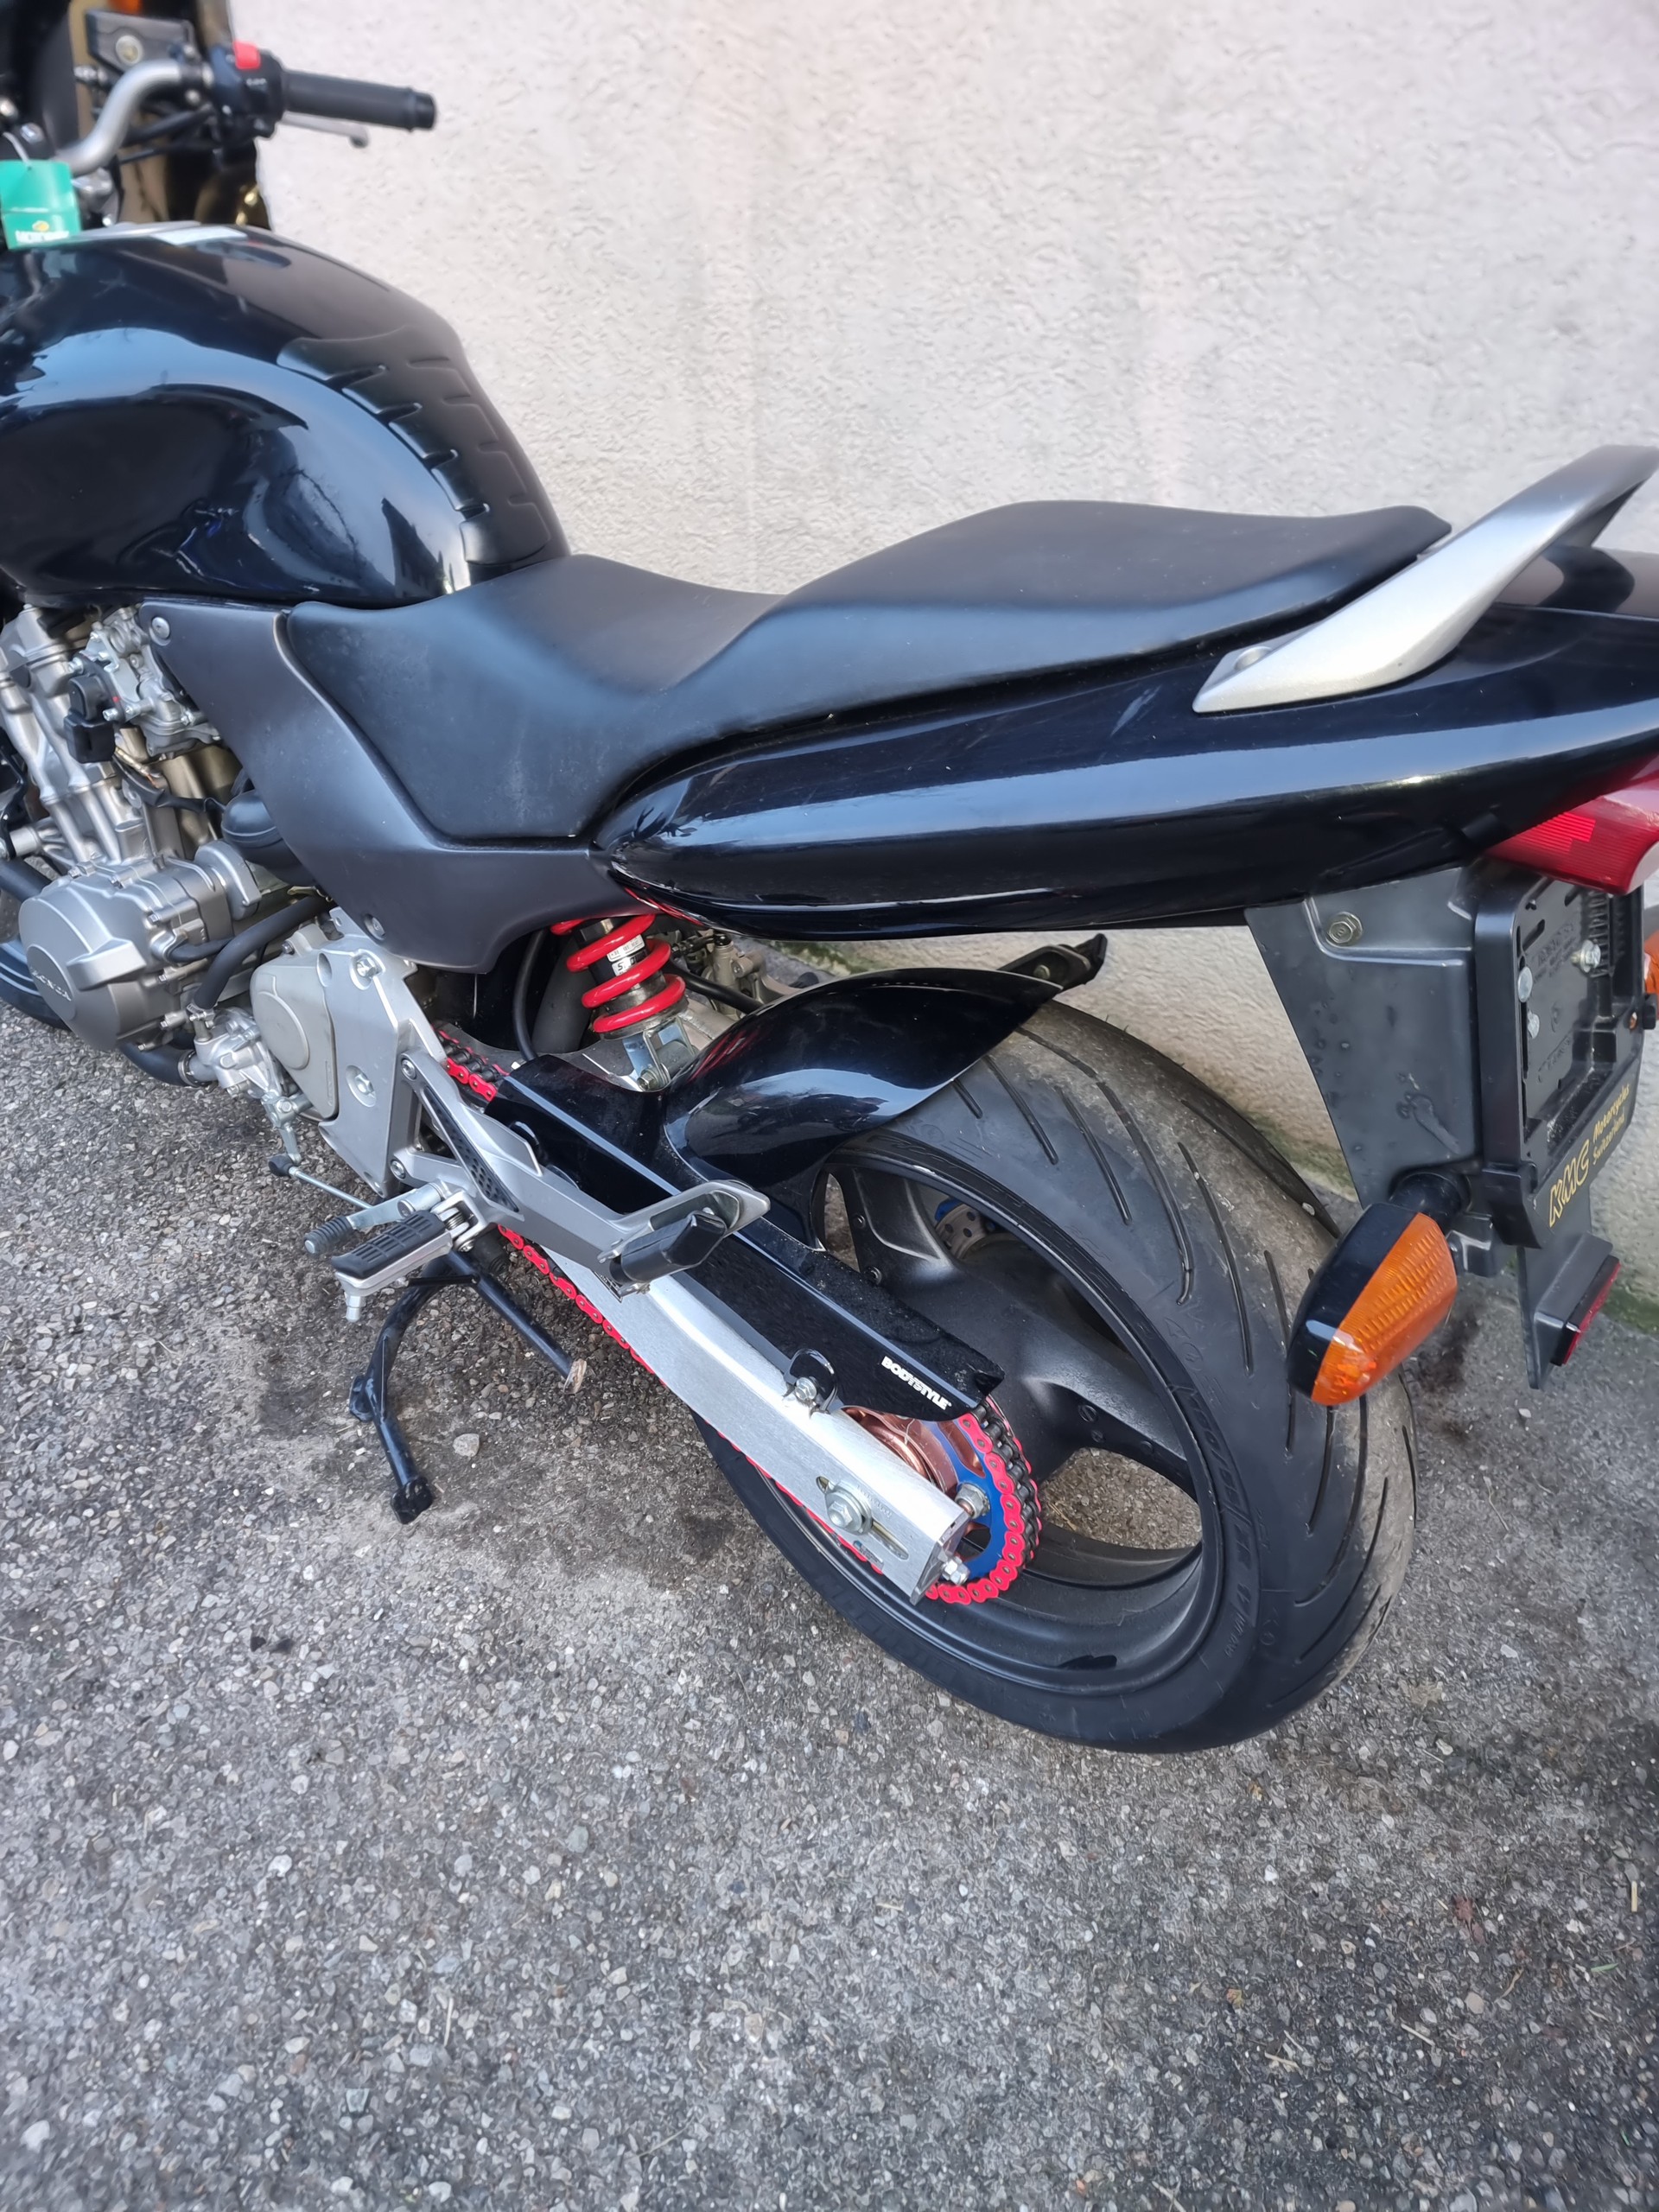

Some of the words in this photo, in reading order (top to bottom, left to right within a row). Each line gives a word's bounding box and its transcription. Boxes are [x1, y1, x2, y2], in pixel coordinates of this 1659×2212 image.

[1592, 1083, 1630, 1143] Motorcycles
[1592, 1107, 1625, 1166] Switzerland
[1548, 1139, 1590, 1228] KMC
[881, 1356, 950, 1410] BODYSTYLE
